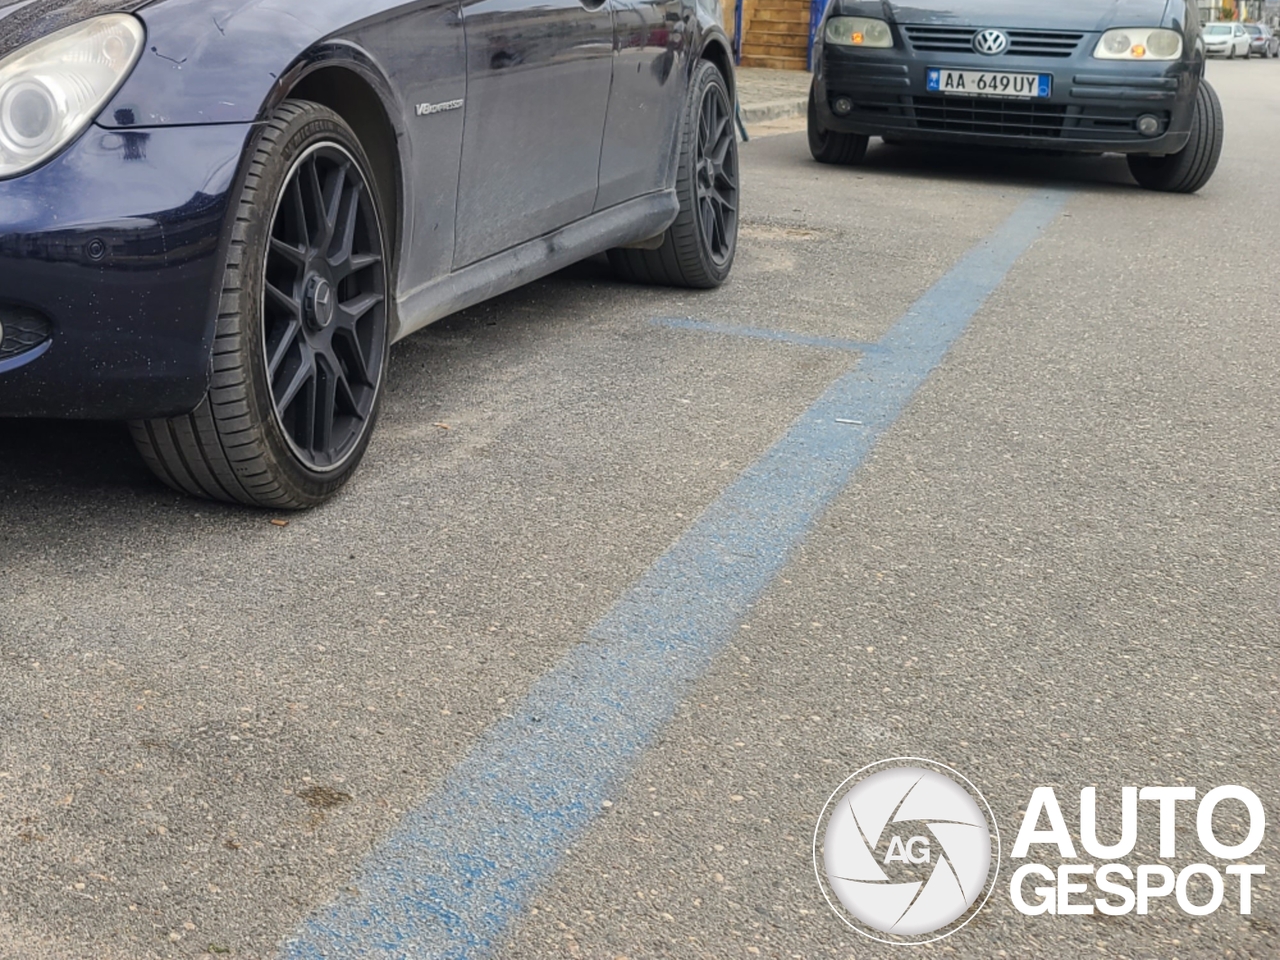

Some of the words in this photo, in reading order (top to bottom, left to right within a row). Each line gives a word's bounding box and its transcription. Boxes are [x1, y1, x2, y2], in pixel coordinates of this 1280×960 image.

[944, 72, 966, 89] AA
[976, 74, 1011, 91] 649
[1013, 75, 1036, 93] UY
